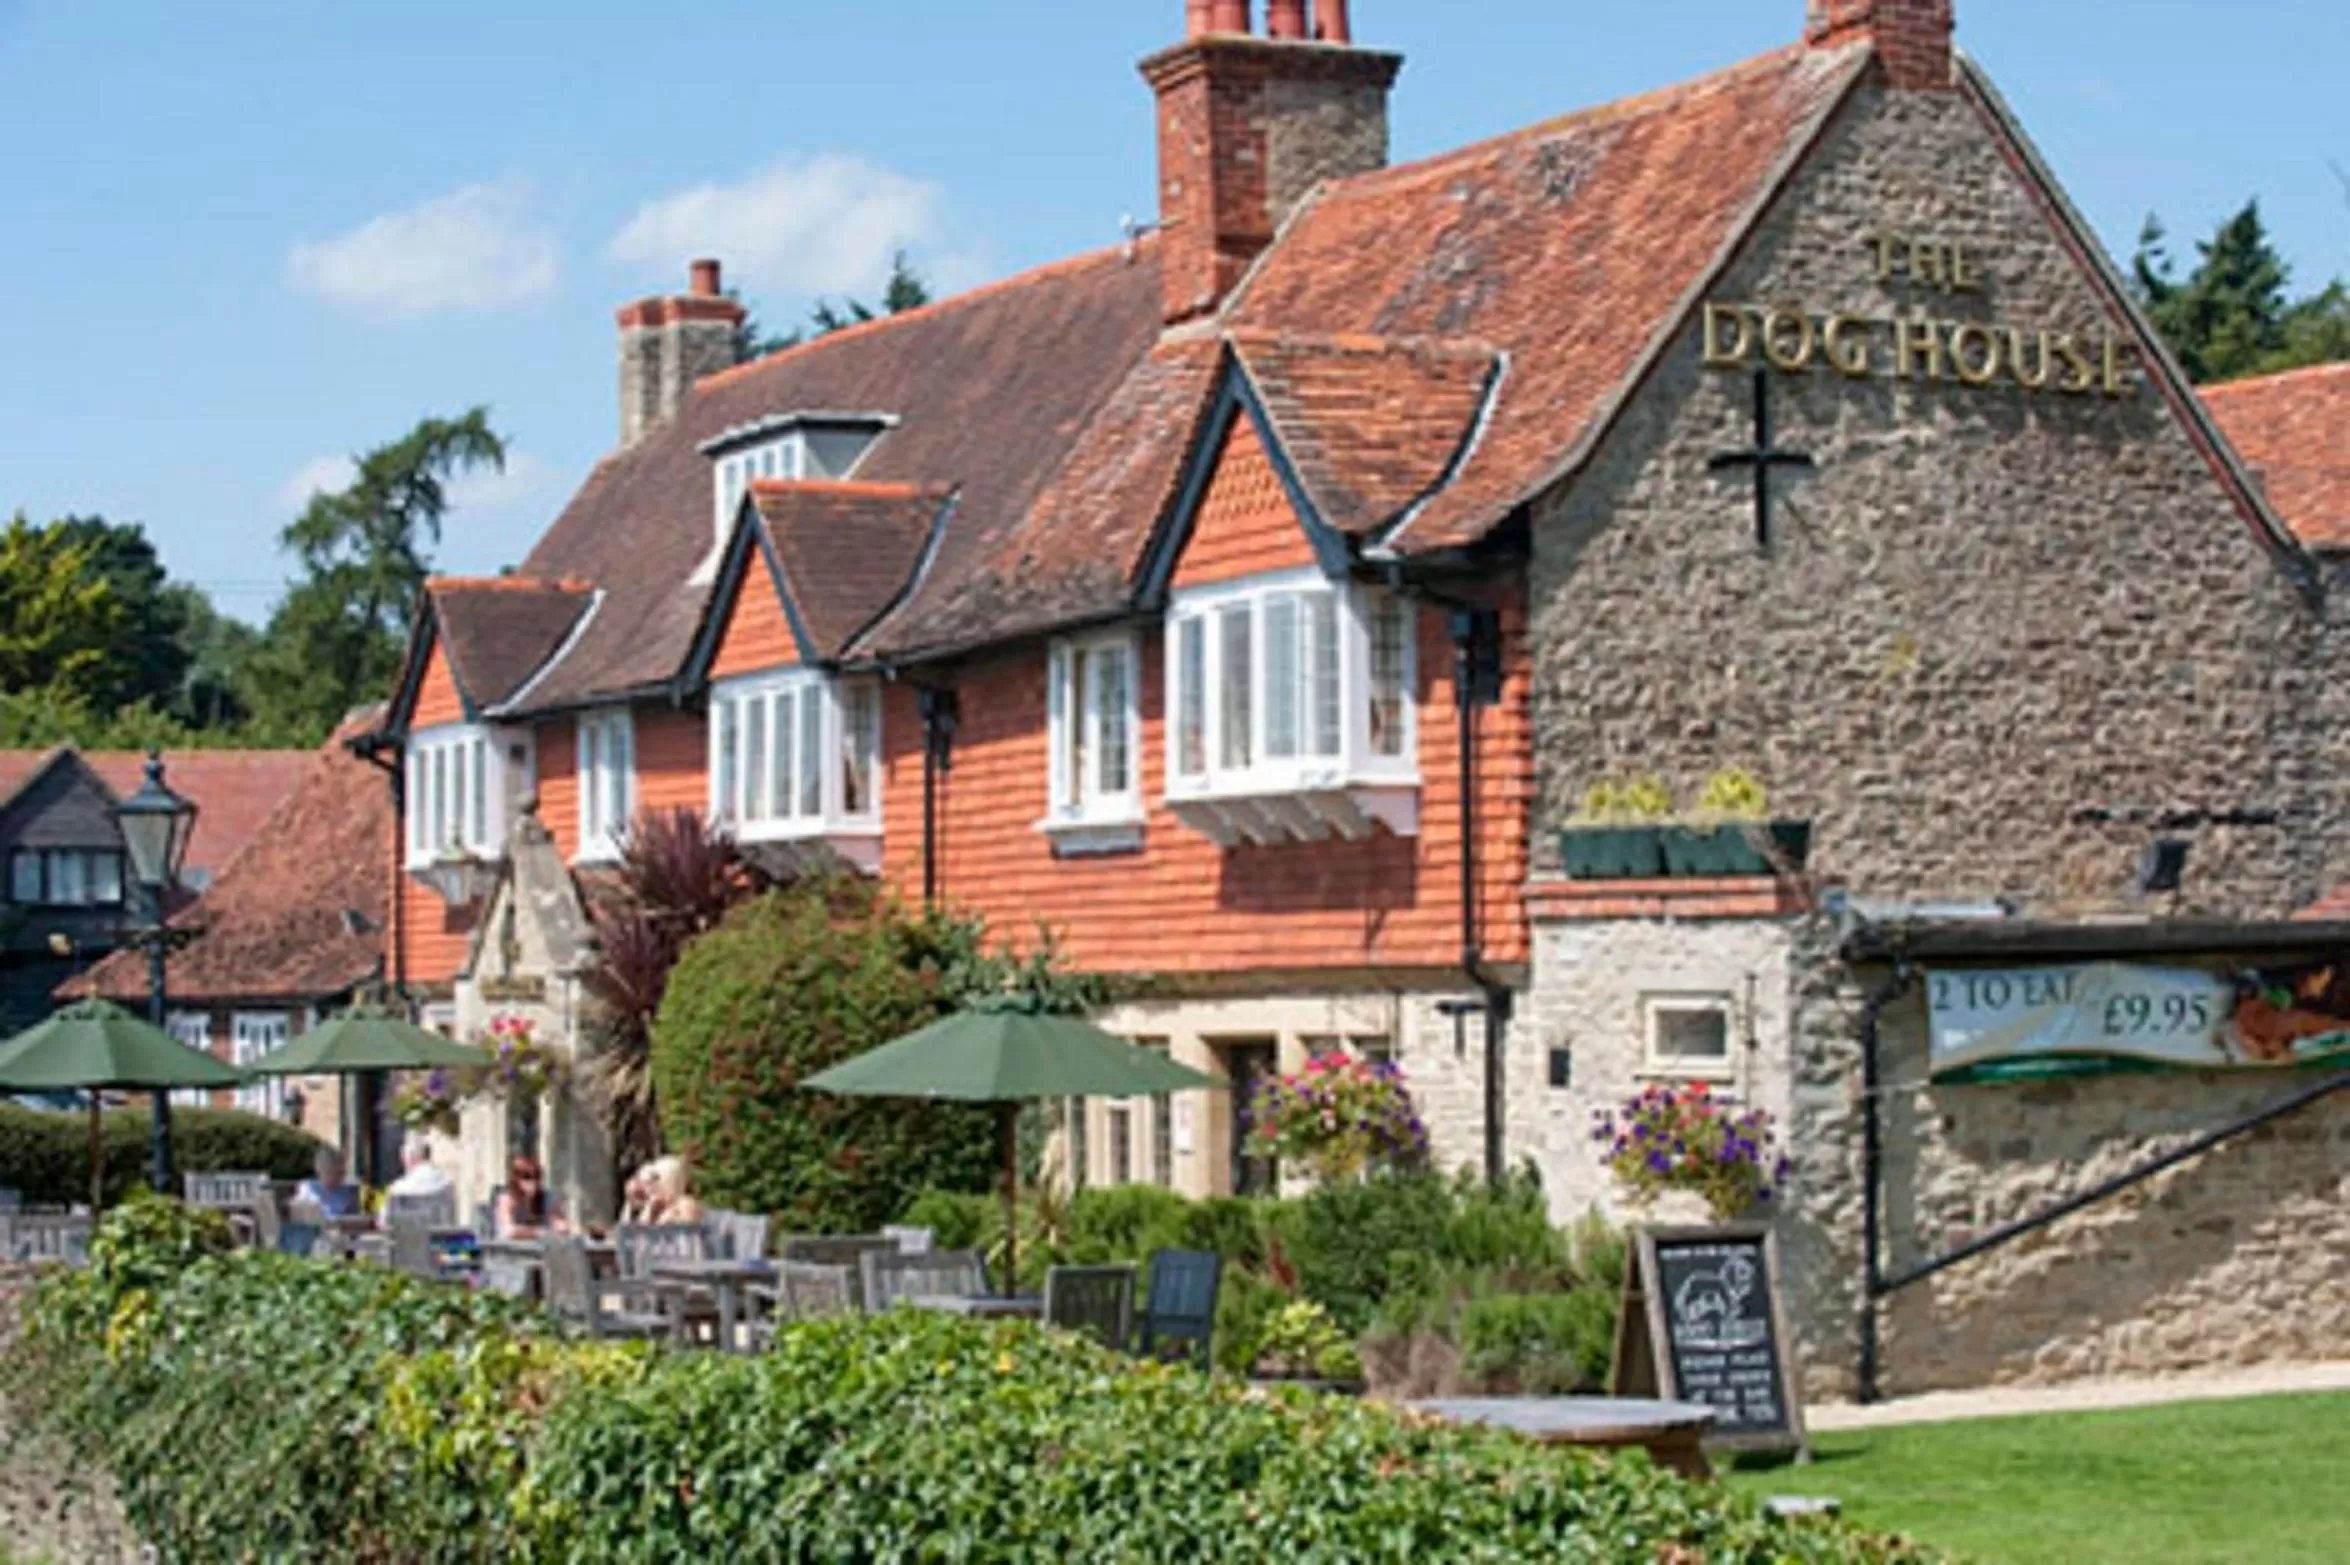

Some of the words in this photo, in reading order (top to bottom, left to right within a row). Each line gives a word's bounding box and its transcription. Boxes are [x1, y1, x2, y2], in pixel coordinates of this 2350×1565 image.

[1867, 235, 1980, 287] THE
[1703, 302, 1869, 379] DOG
[1896, 313, 2138, 398] HOUSE
[1934, 977, 1952, 1010] 2
[1960, 973, 2012, 1010] TO
[2103, 993, 2209, 1037] £9.95
